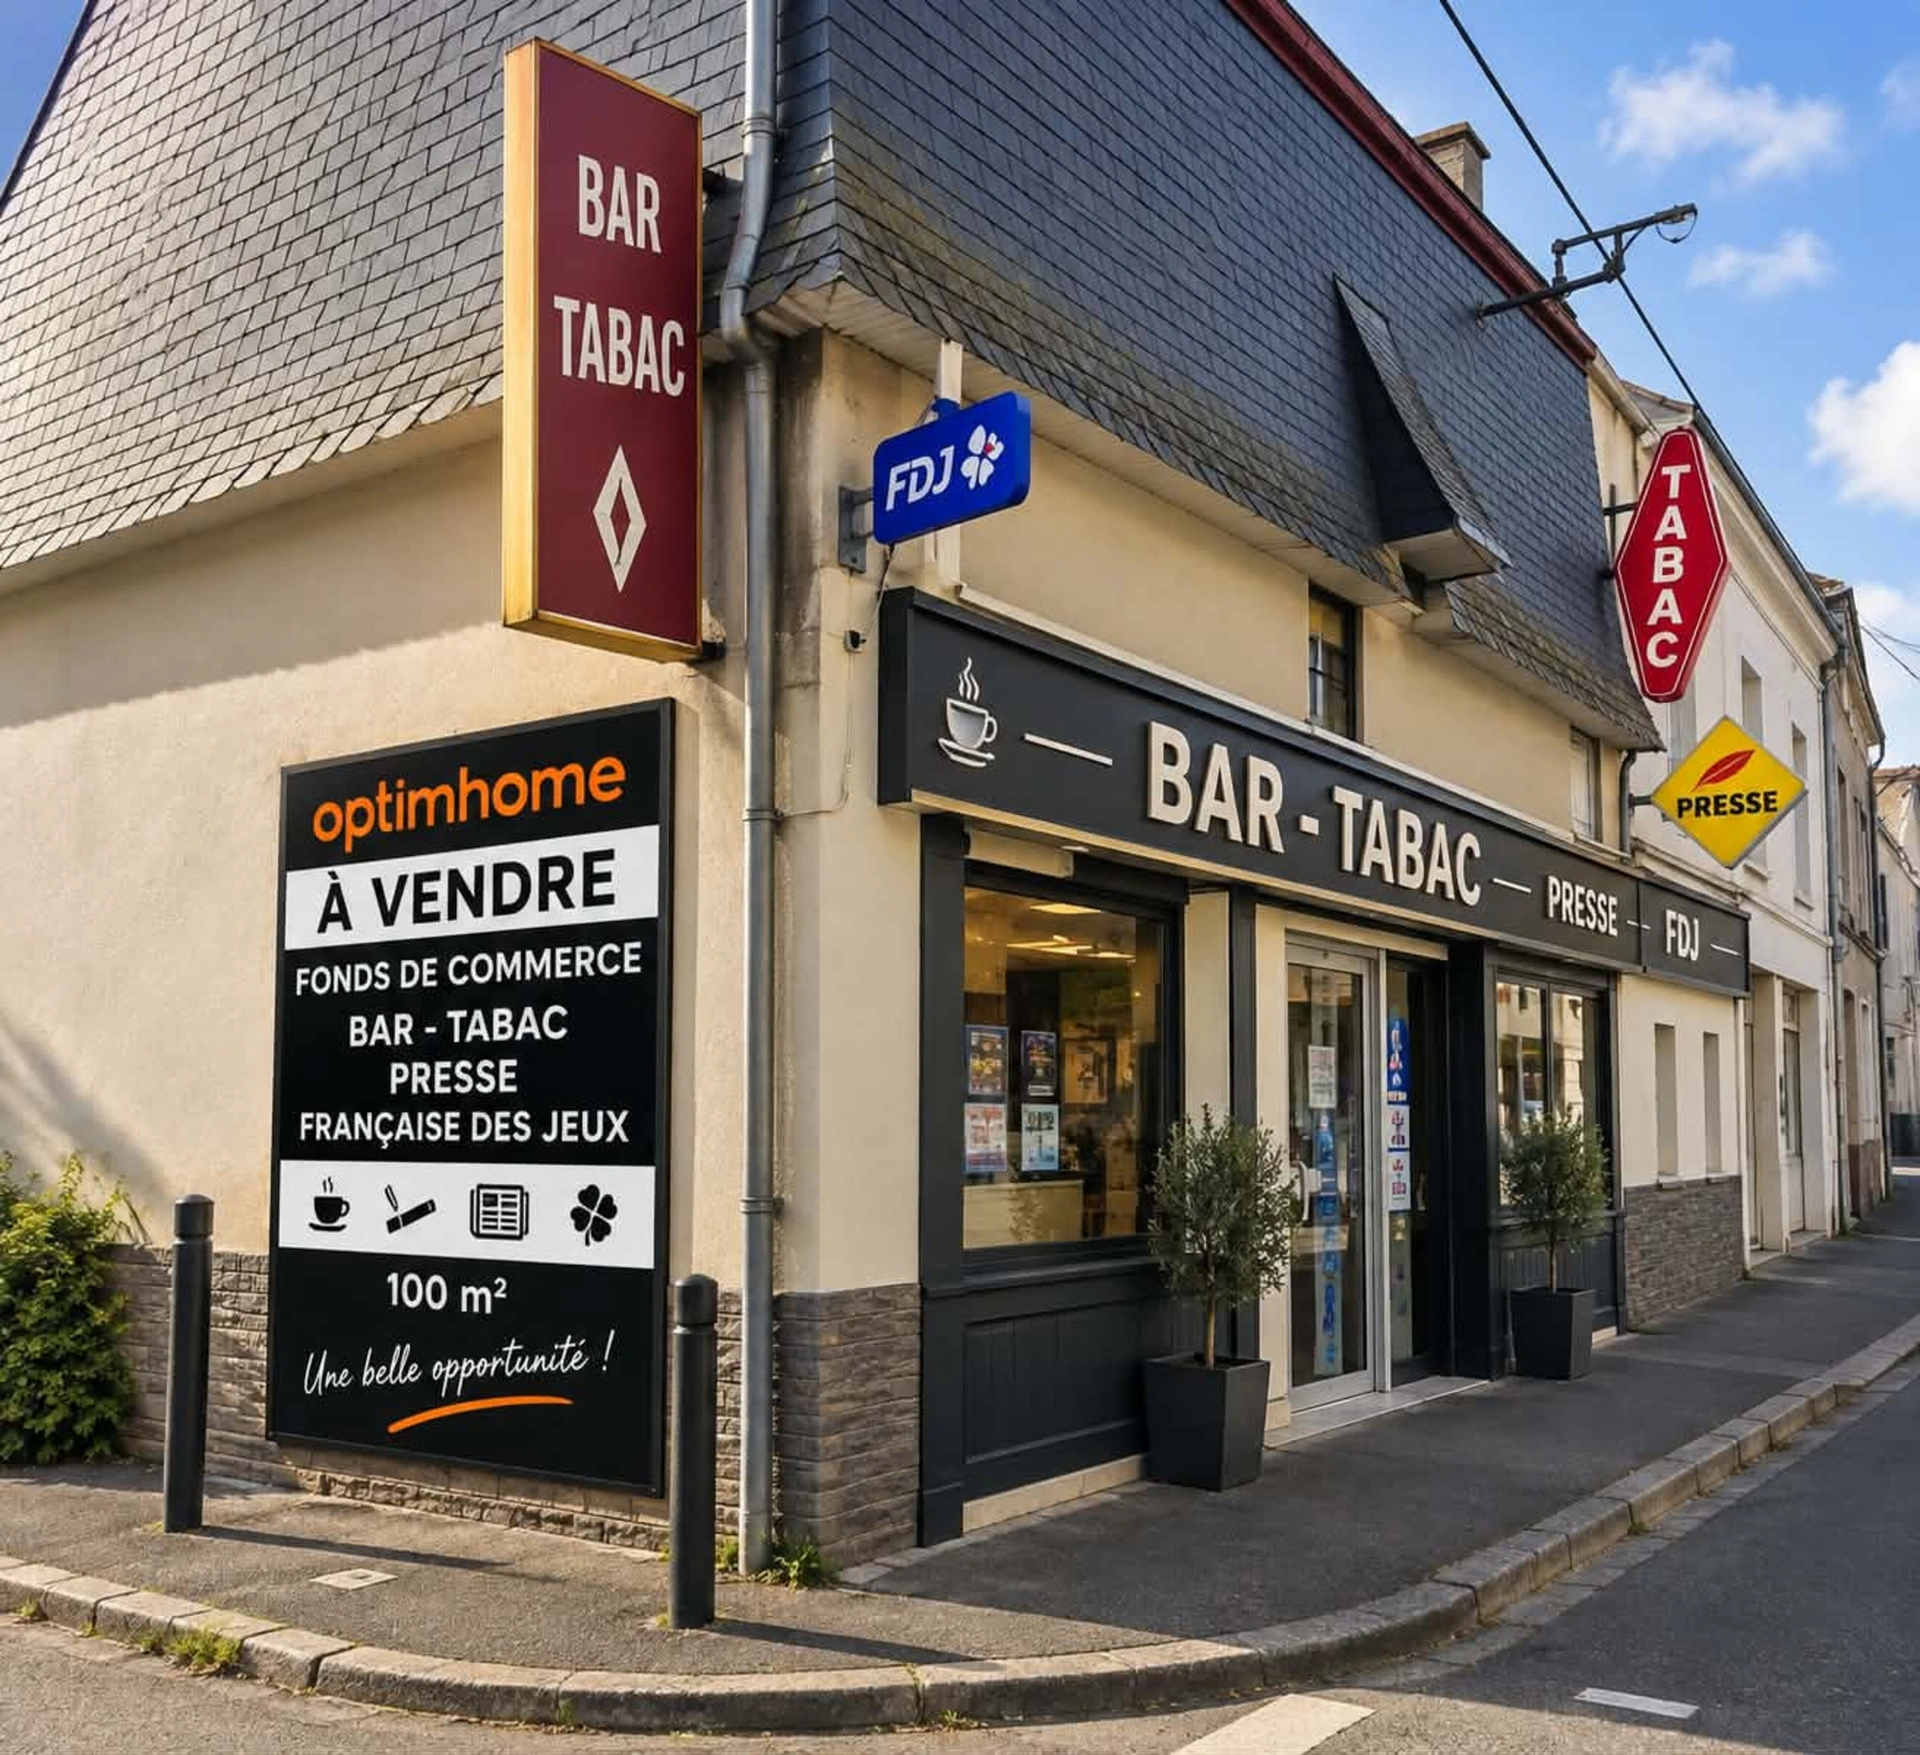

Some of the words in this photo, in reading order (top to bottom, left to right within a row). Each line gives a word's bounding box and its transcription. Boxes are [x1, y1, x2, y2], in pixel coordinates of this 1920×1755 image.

[578, 154, 662, 253] BAR
[553, 294, 685, 397] TABAC
[886, 445, 955, 511] FDJ
[1647, 463, 1692, 669] TABAC
[313, 756, 626, 853] optimhome
[1677, 790, 1778, 819] PRESSE
[1147, 721, 1285, 855] BAR
[1332, 785, 1481, 907] TABAC
[1548, 875, 1619, 938] PRESSE
[1665, 908, 1700, 962] FDJ
[317, 871, 352, 934] À
[371, 848, 616, 928] VENDRE
[296, 961, 391, 996] FONDS
[400, 957, 438, 989] DE
[447, 941, 642, 986] COMMERCE
[349, 1013, 413, 1047] BAR
[446, 1004, 568, 1043] TABAC
[390, 1059, 518, 1094] PRESSE
[300, 1111, 461, 1150] FRANÇAISE
[471, 1110, 532, 1142] DES
[541, 1110, 629, 1143] JEUX
[387, 1272, 448, 1310] 100
[461, 1277, 507, 1314] m²
[303, 1349, 352, 1395] Une
[362, 1343, 422, 1387] belle
[432, 1334, 589, 1398] opportunité
[602, 1329, 615, 1371] !
